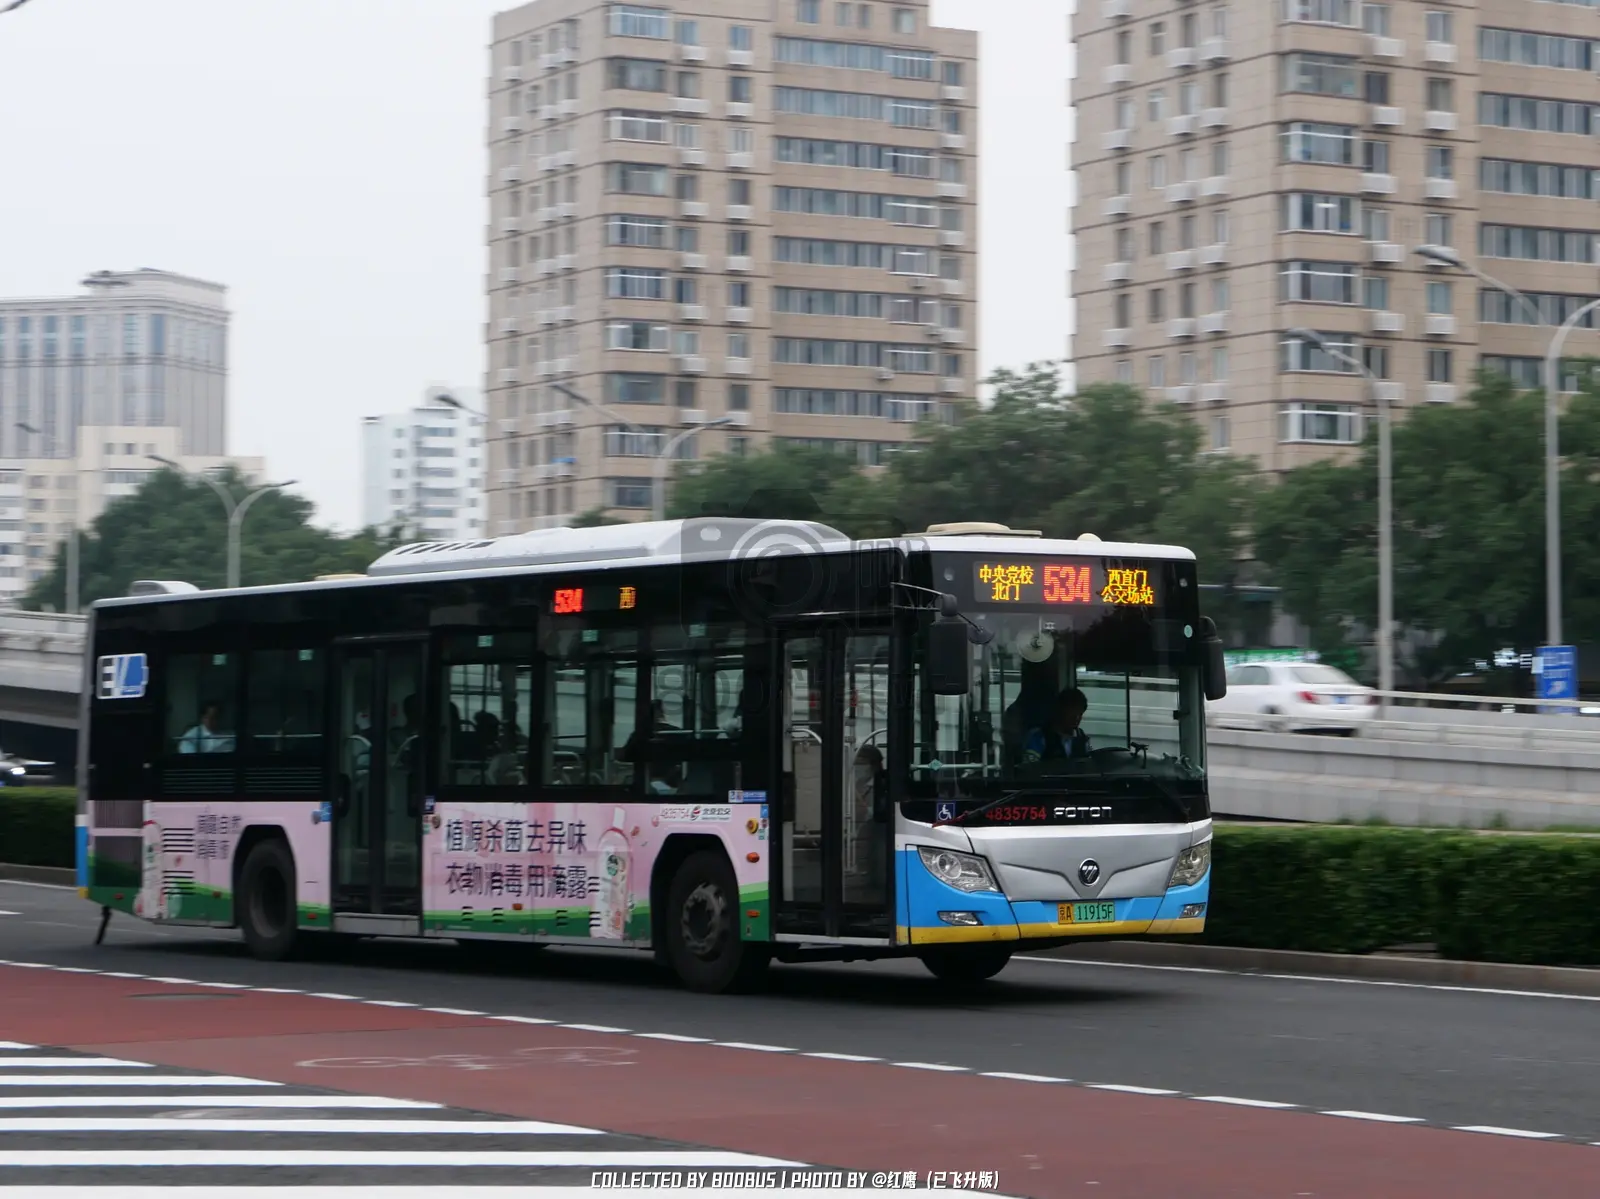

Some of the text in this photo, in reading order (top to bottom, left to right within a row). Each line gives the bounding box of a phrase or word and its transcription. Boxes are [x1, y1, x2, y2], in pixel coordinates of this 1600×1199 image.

[979, 564, 1034, 585] 中央党校
[1042, 566, 1092, 603] 534
[1108, 568, 1148, 587] 西直门
[554, 588, 583, 613] 534
[991, 583, 1020, 602] 北门
[1101, 585, 1154, 605] 公交场站
[985, 806, 1047, 821] 4835754
[1053, 806, 1112, 819] FOTON
[445, 819, 588, 855] 植源杀菌去异味
[445, 864, 588, 900] 衣物消毒用滴露
